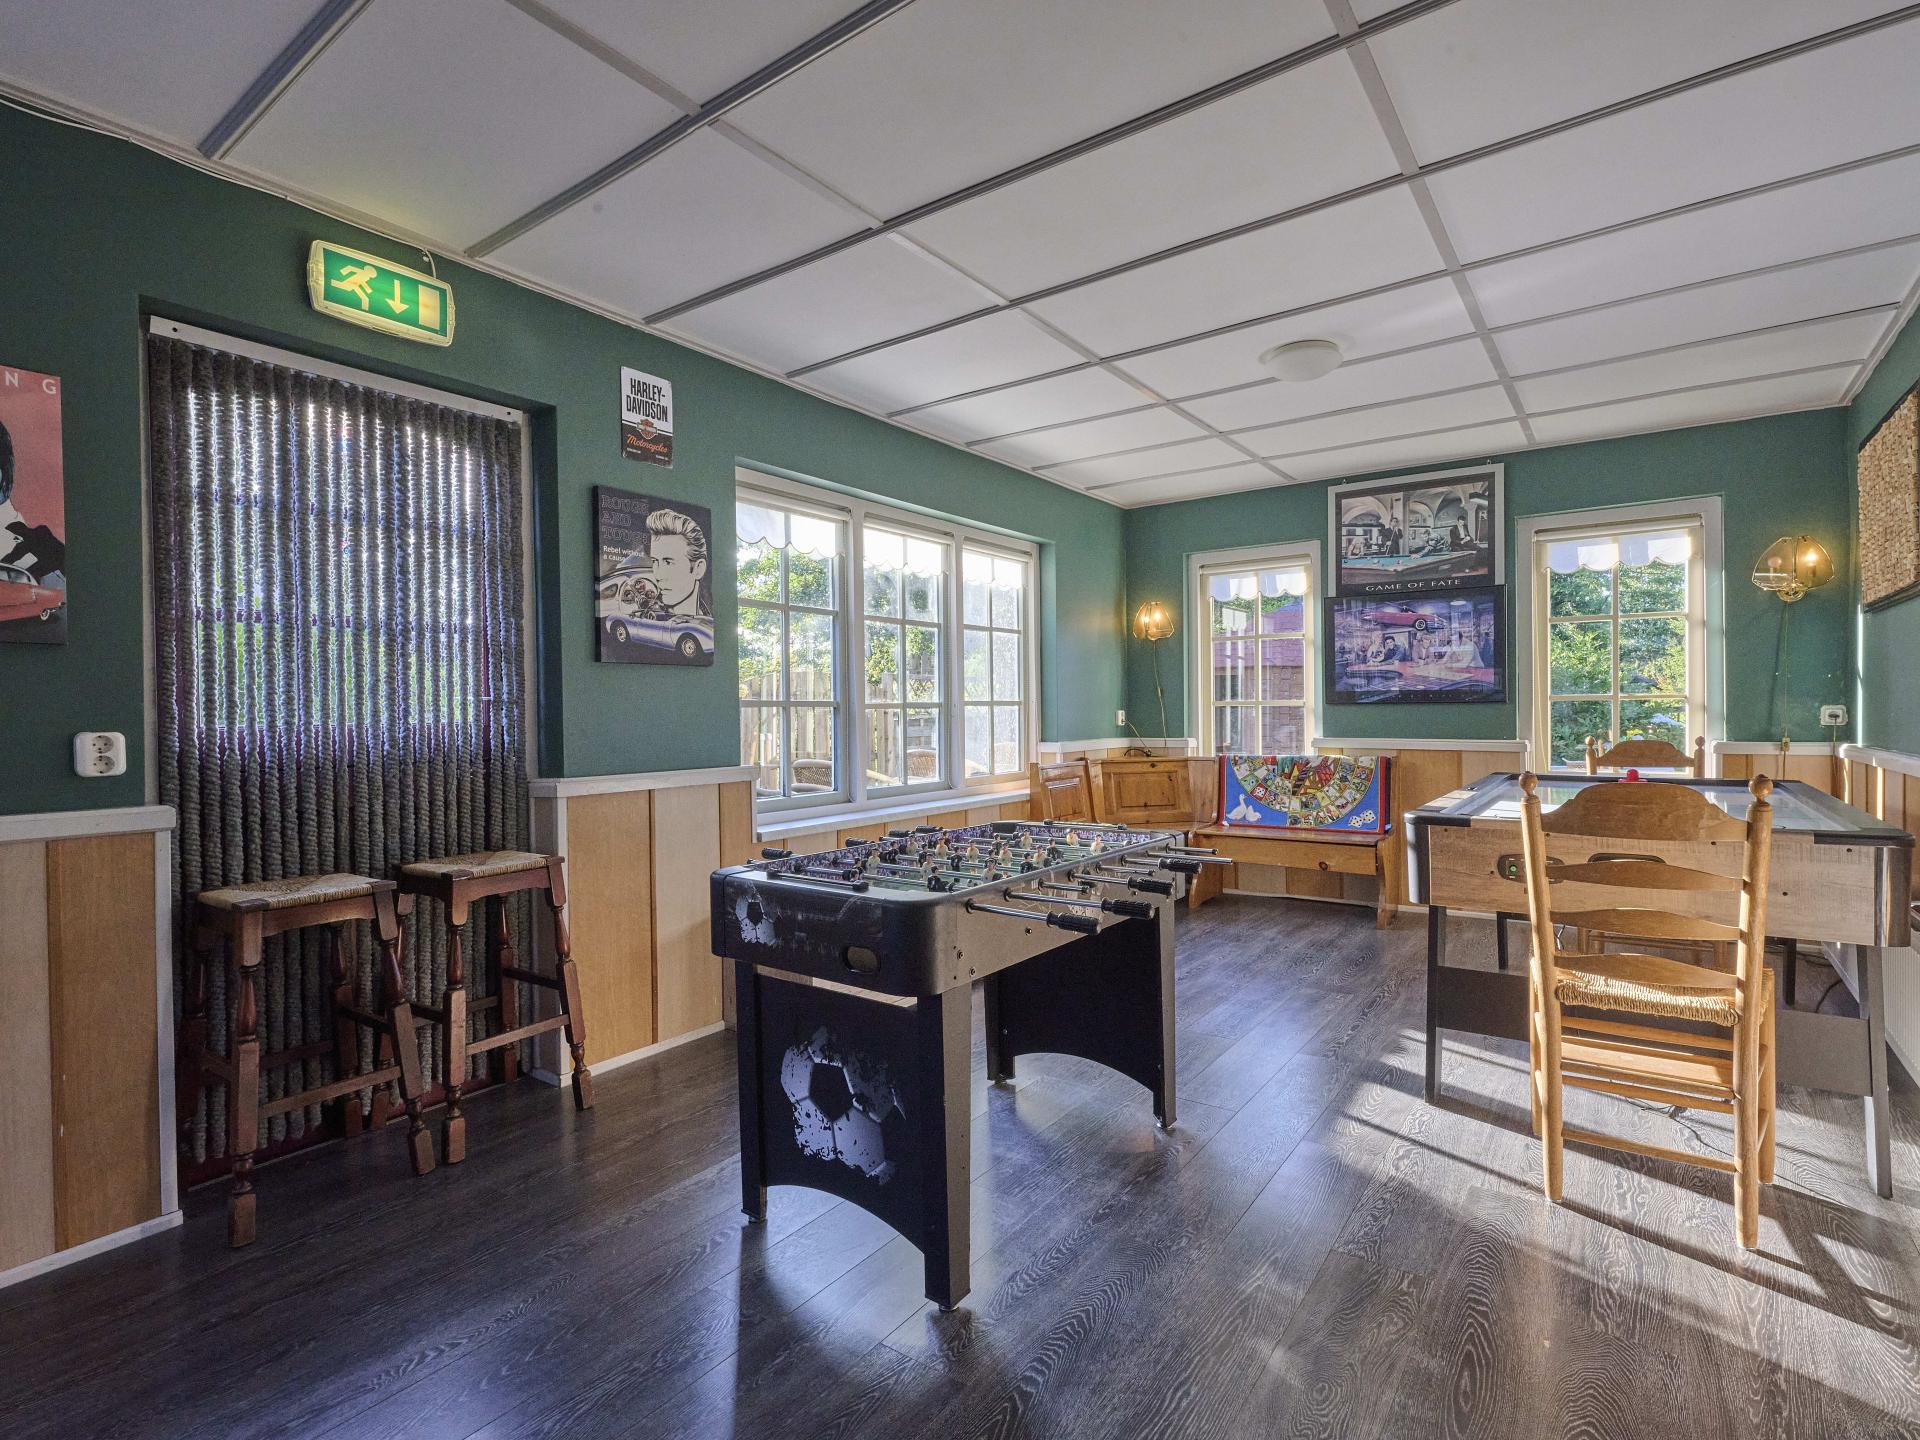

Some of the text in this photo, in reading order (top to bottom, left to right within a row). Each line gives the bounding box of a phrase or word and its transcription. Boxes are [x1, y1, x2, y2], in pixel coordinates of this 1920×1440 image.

[630, 378, 665, 402] HARLEY-
[626, 395, 668, 422] DAVIDSON
[627, 434, 668, 453] Motorcycles
[603, 545, 645, 557] Rebel without
[1365, 583, 1402, 591] GAME
